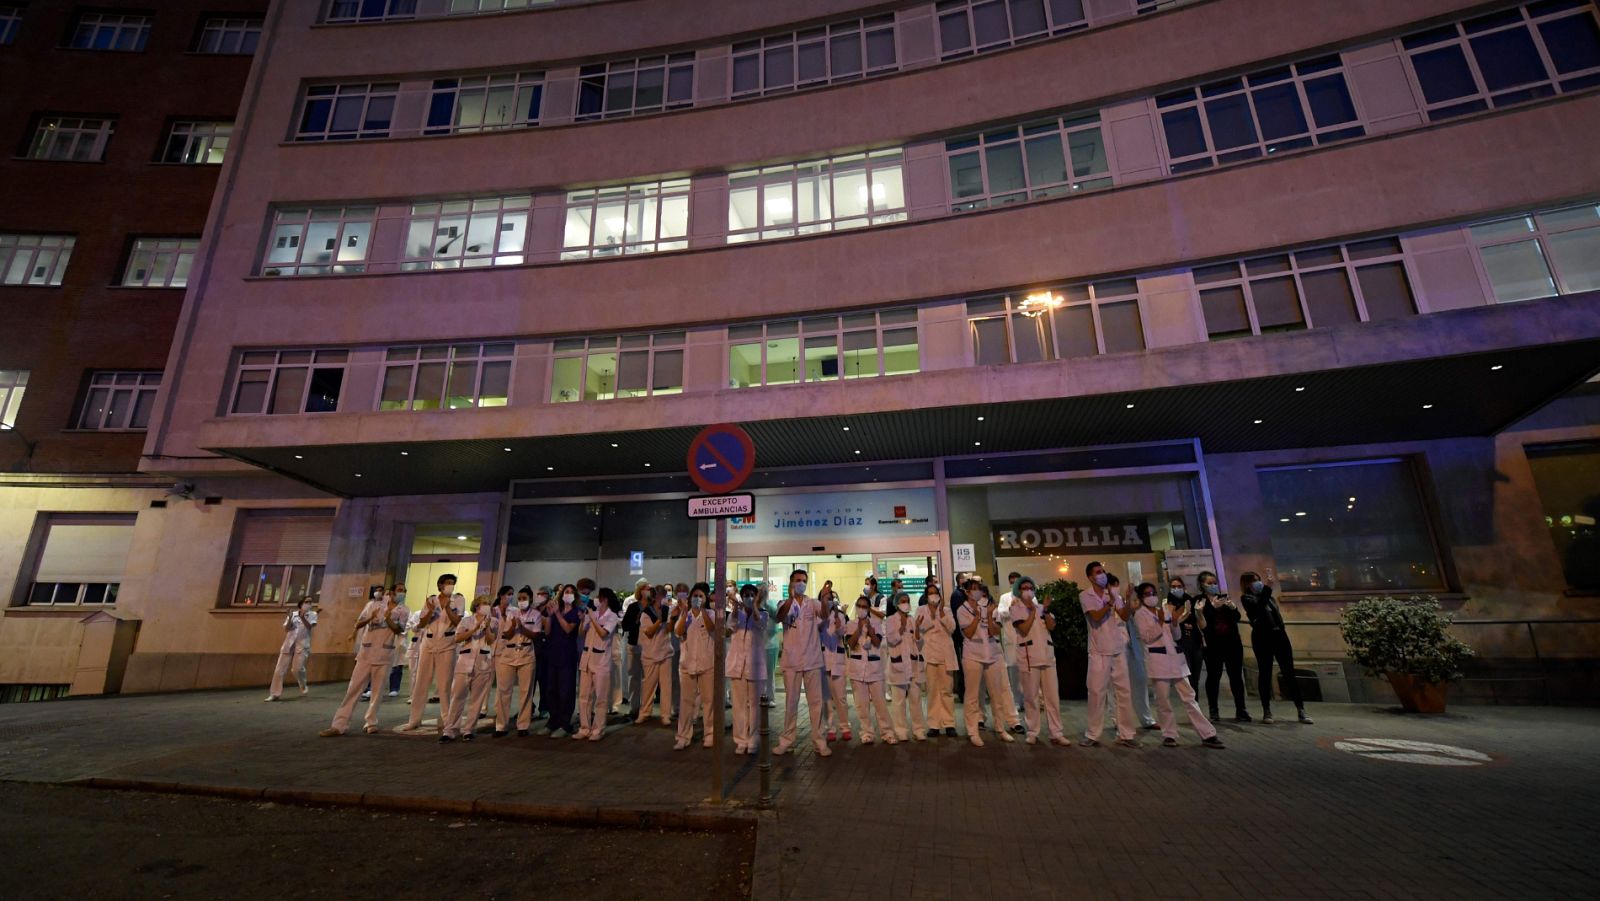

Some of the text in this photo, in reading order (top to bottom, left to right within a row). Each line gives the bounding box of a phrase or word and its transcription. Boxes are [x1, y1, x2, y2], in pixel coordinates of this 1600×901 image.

[702, 497, 738, 506] EXCEPTO
[693, 505, 748, 515] AMBULANCIAS
[774, 517, 828, 528] Jiménez
[1000, 525, 1144, 549] RODILLA
